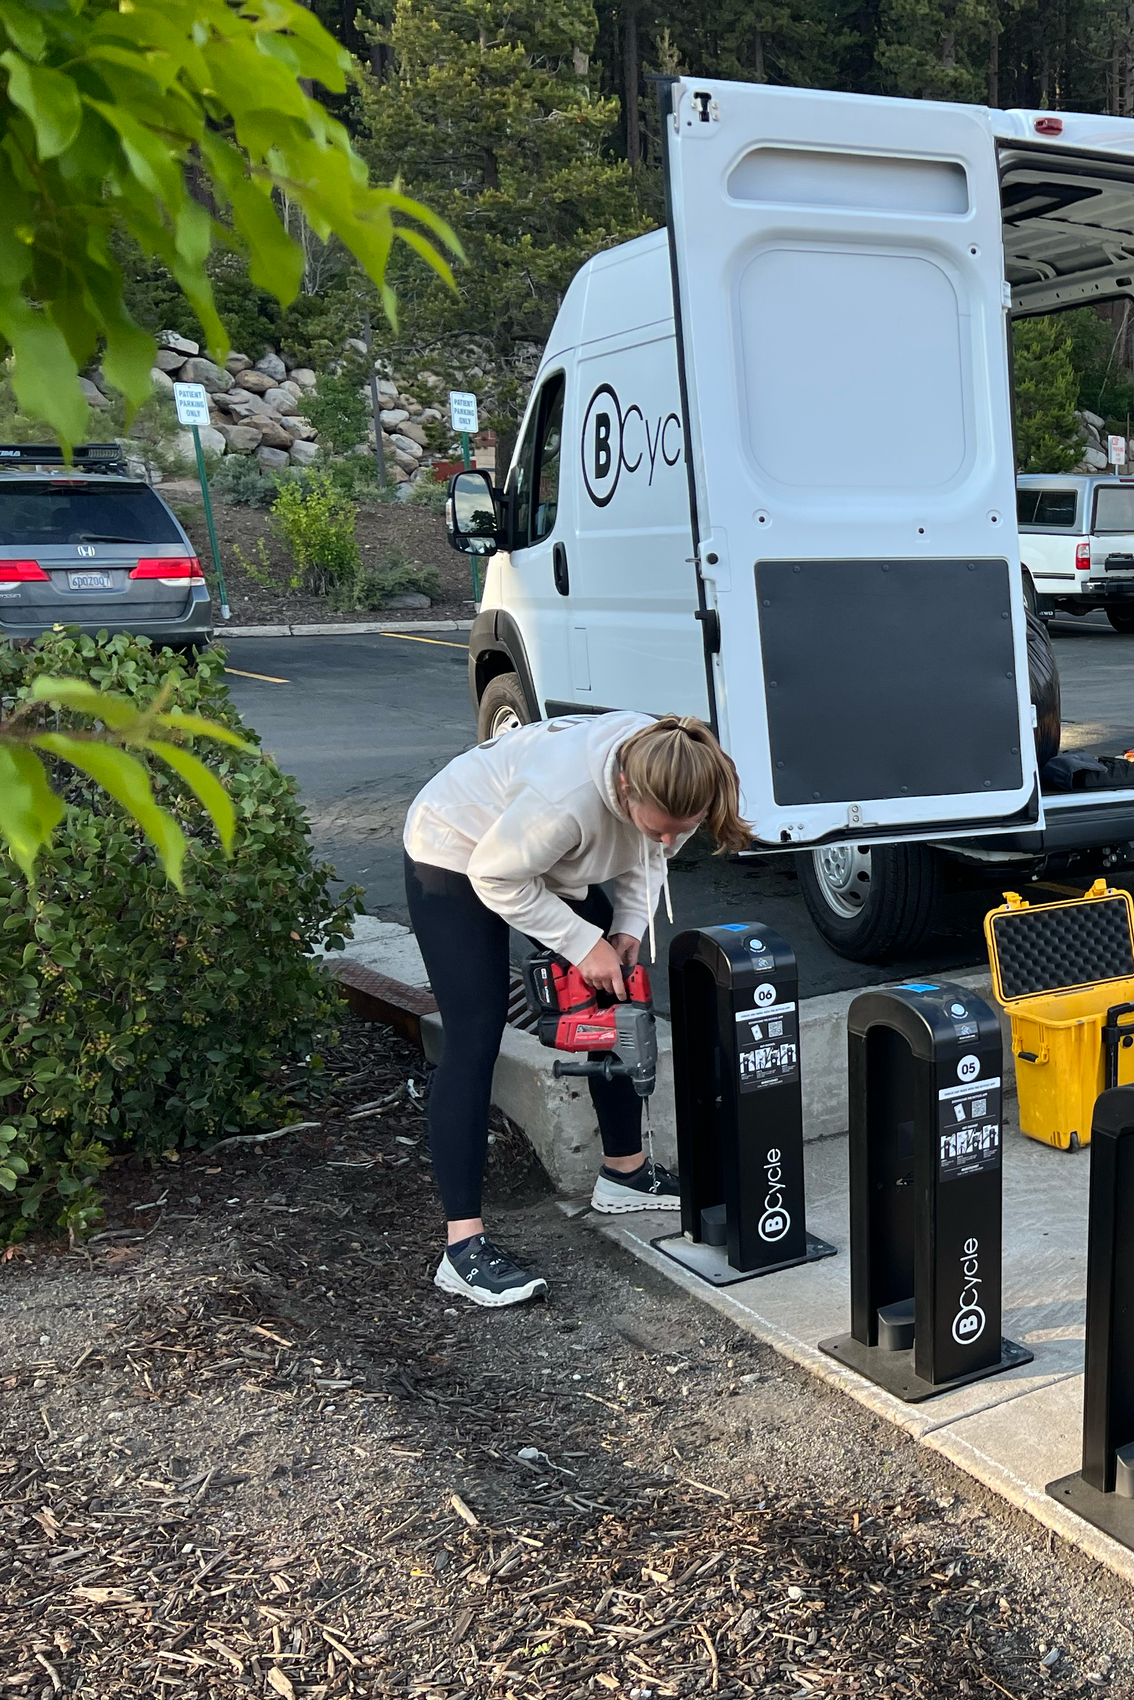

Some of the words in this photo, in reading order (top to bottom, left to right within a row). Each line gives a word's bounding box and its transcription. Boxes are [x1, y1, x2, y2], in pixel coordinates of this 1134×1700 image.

[178, 390, 202, 399] PATIENT
[179, 400, 204, 409] PARKING
[454, 399, 473, 408] PATIENT
[454, 408, 475, 416] PARKING
[459, 417, 471, 425] ONLY
[580, 383, 687, 508] BCyc
[758, 990, 773, 1001] 06
[961, 1063, 976, 1075] 05
[758, 1148, 791, 1242] BCycle
[952, 1237, 986, 1345] BCycle
